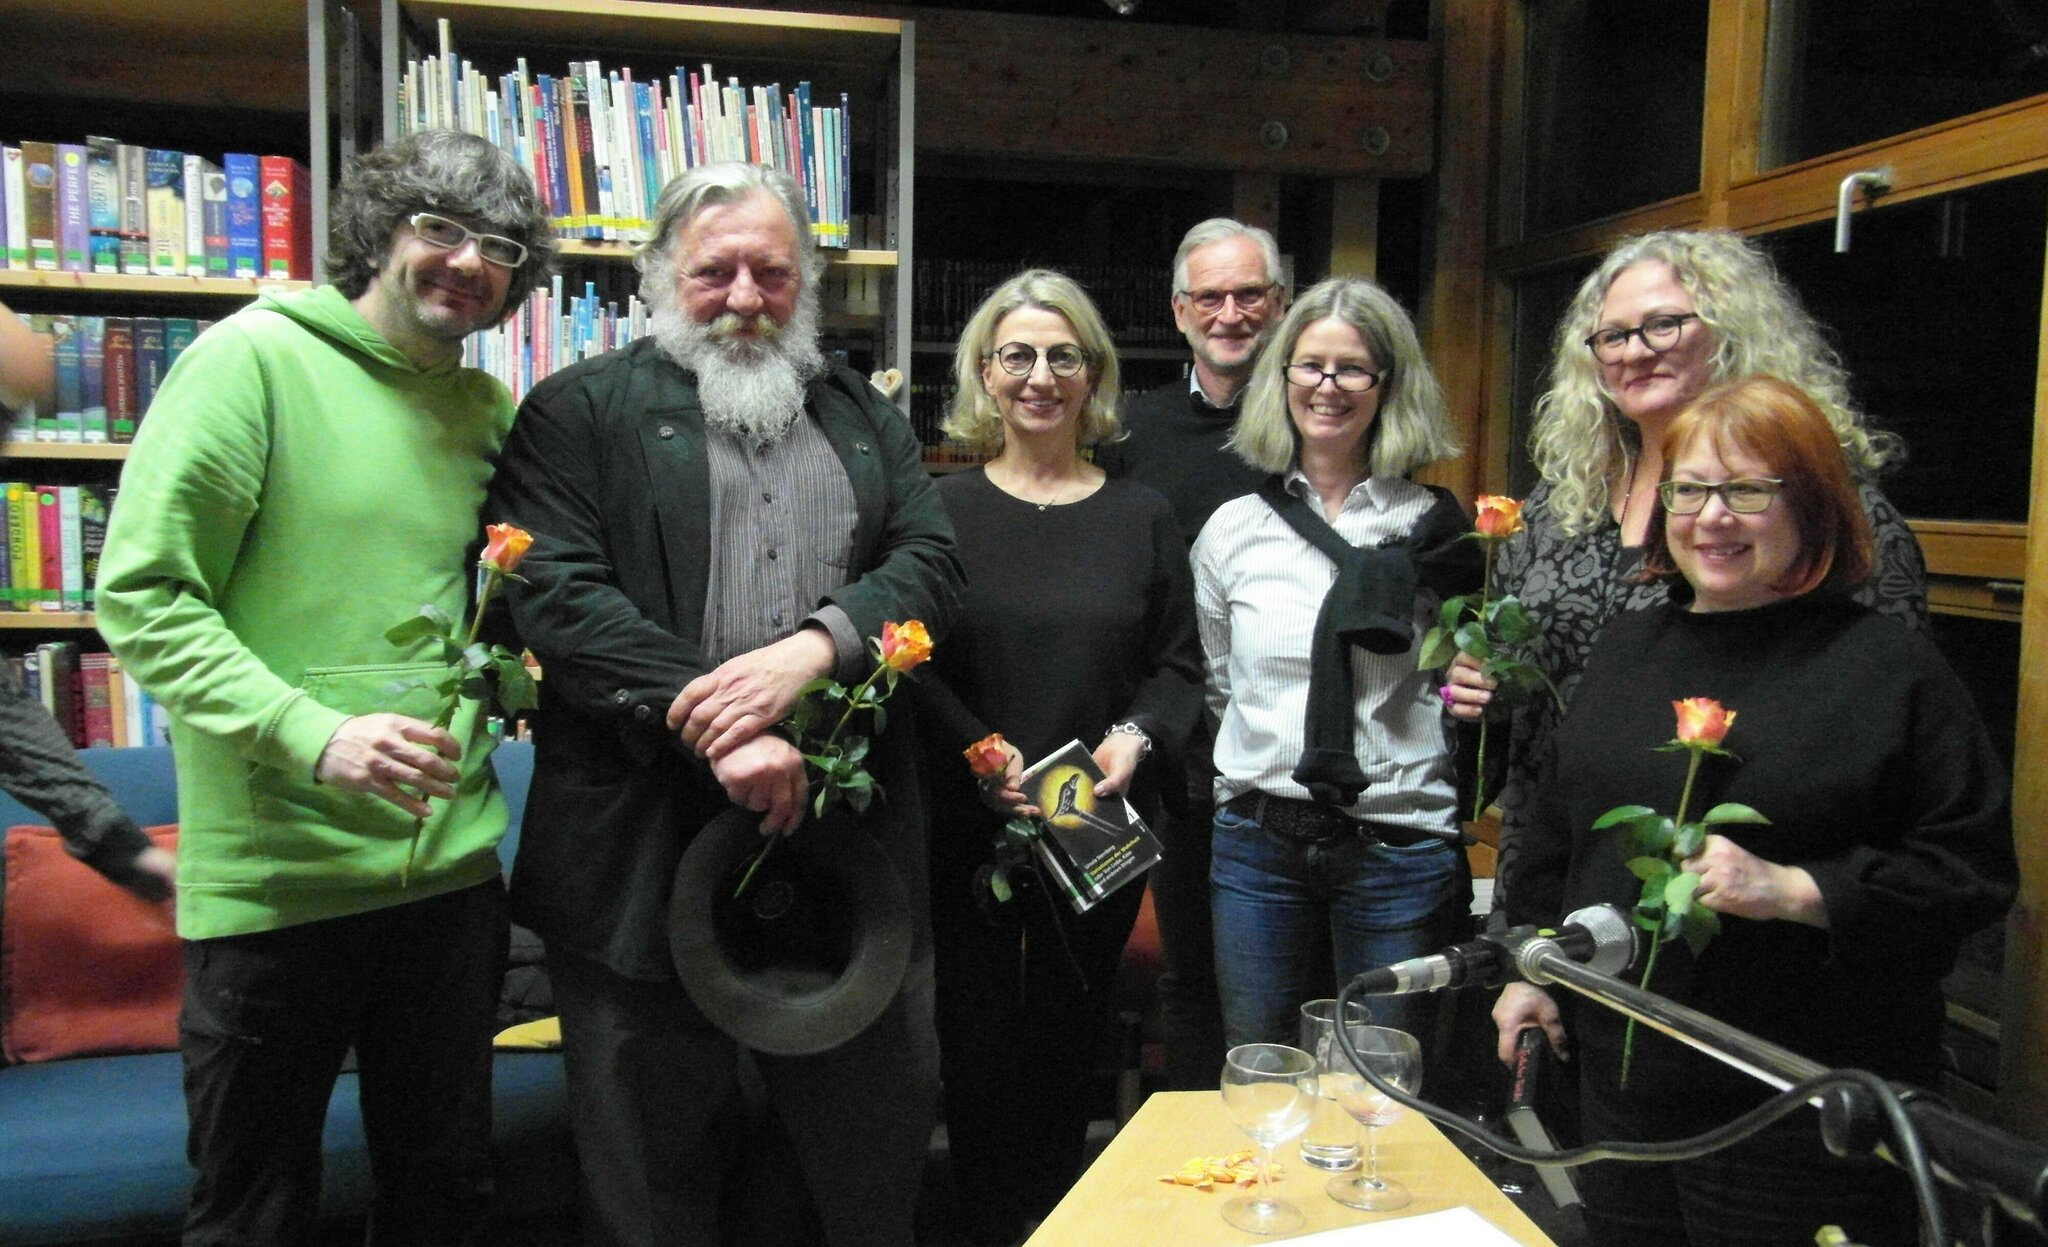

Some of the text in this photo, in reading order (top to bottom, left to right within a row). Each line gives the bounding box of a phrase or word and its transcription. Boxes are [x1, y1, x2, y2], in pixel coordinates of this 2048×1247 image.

[65, 166, 80, 225] THE PERFE
[8, 500, 21, 560] PONDERO
